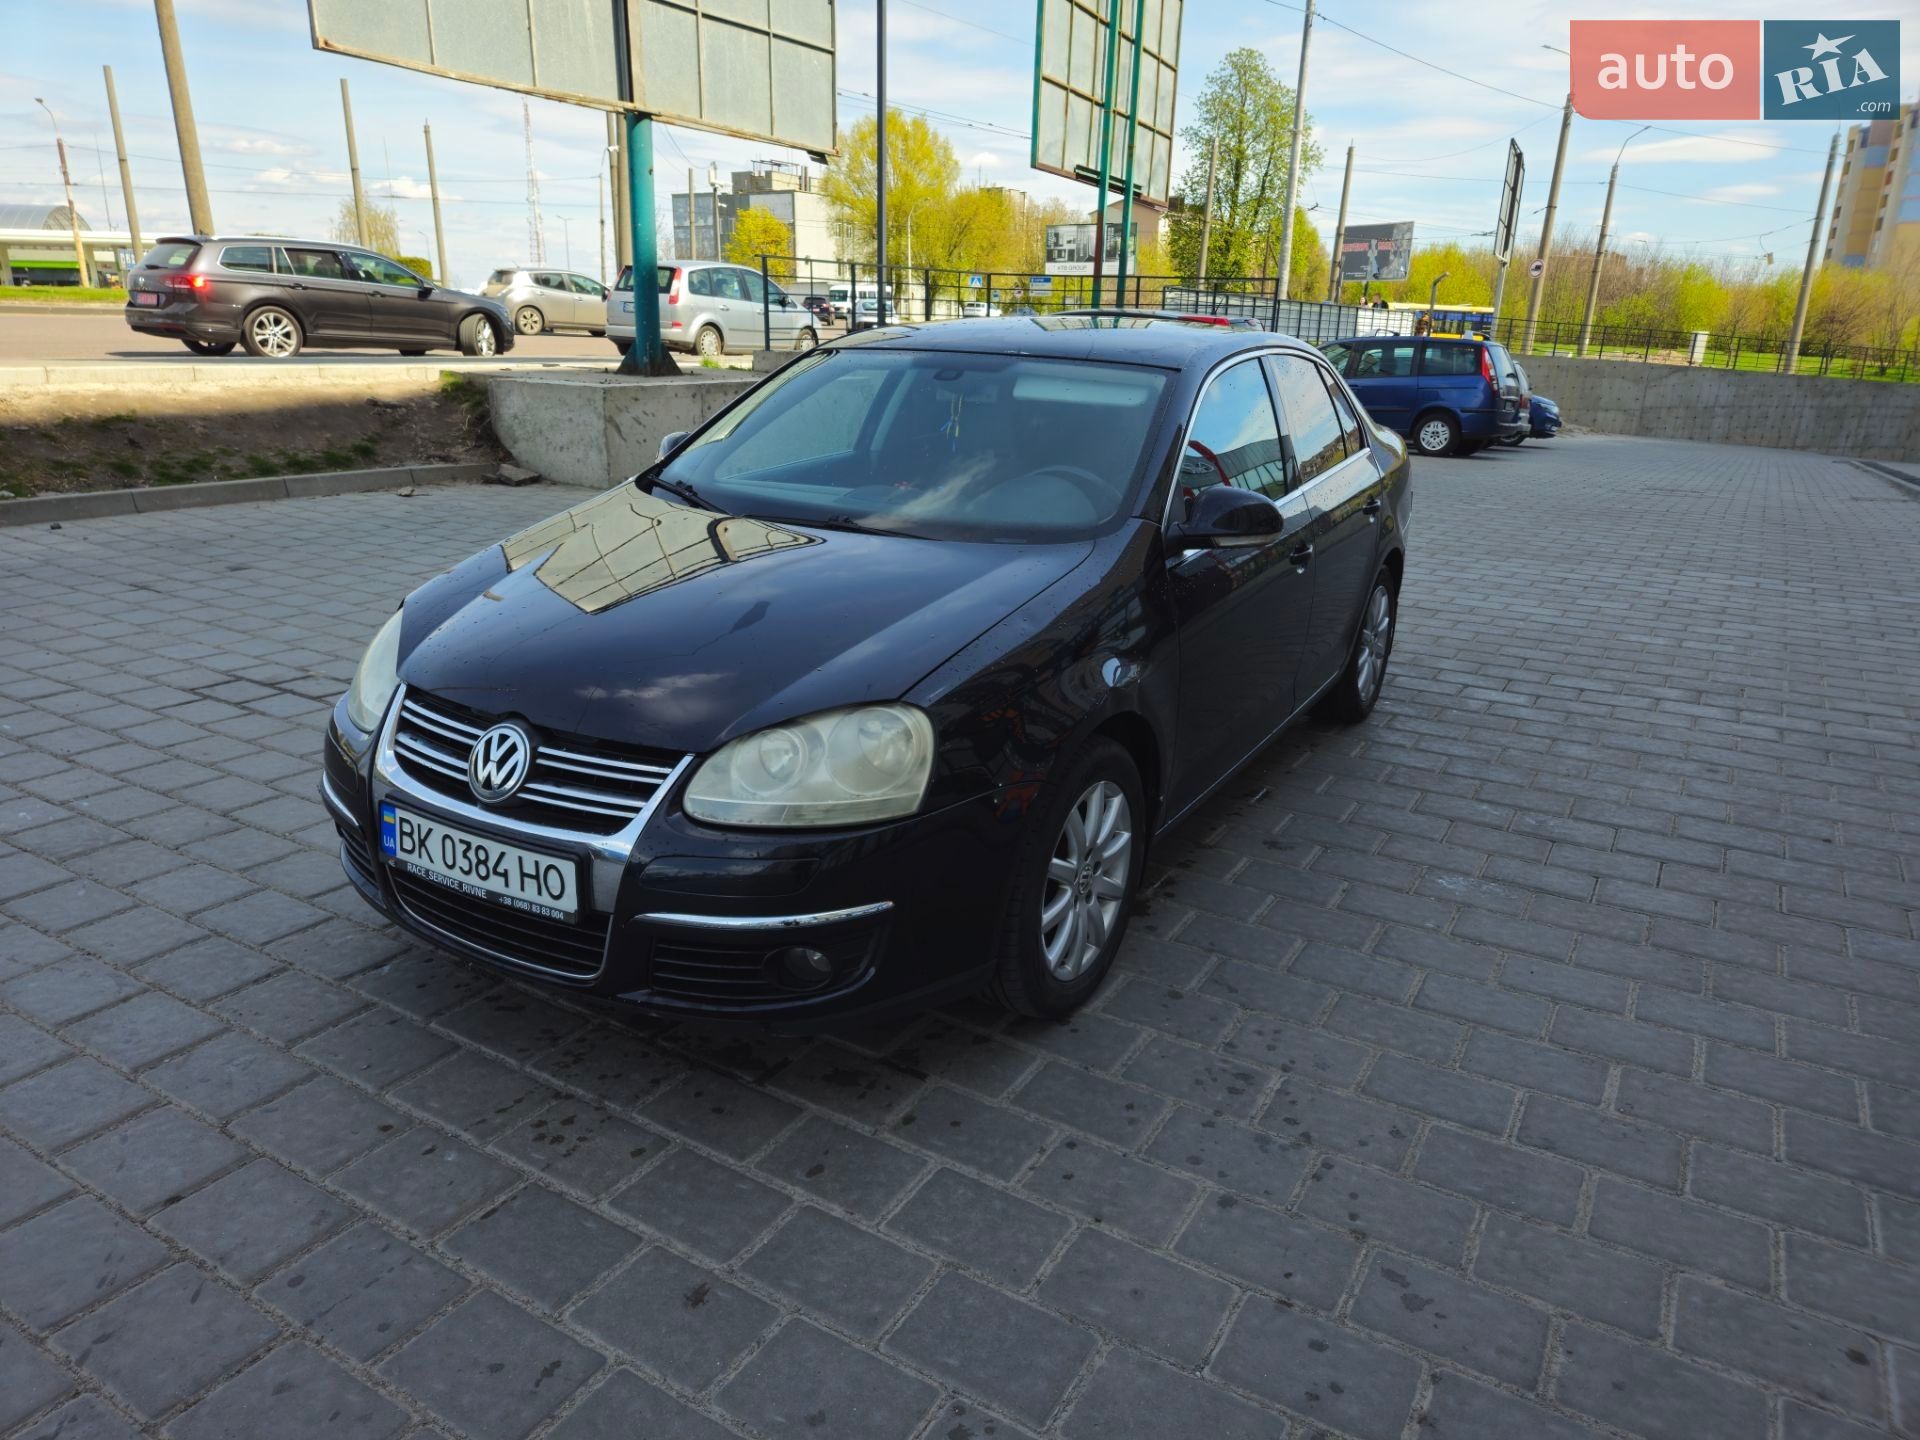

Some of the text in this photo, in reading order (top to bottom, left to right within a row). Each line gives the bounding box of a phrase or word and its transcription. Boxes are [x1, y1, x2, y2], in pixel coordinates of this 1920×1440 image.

[383, 835, 395, 850] UA
[398, 816, 566, 901] BK 0384 HO
[499, 896, 512, 906] +38
[541, 906, 551, 917] 83
